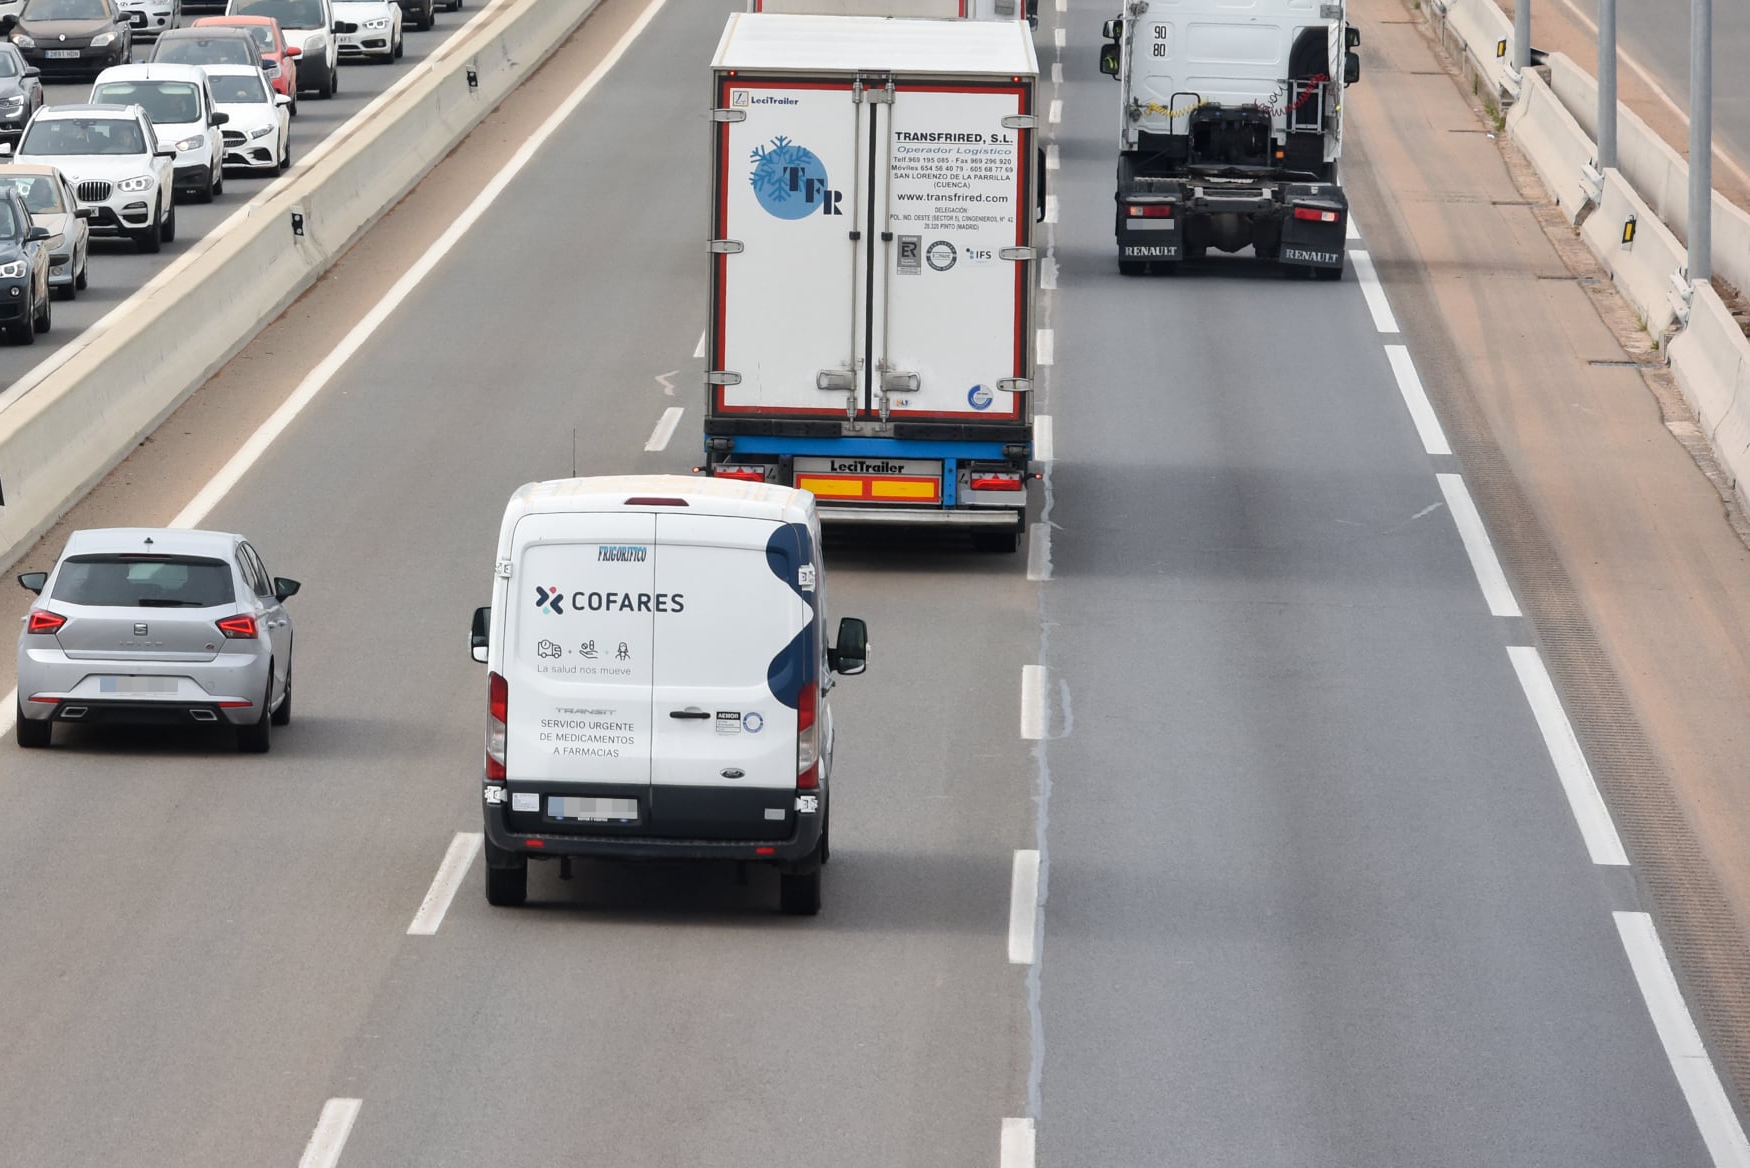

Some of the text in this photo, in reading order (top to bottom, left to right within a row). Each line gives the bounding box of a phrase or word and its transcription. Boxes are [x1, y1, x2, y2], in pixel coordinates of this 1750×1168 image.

[1153, 25, 1167, 40] 90
[1153, 43, 1166, 57] 80
[751, 96, 799, 106] LeciTrailer
[895, 132, 1013, 144] TRANSFRIRED, S.L.
[897, 145, 953, 155] Operador
[783, 167, 843, 215] TFR
[933, 181, 971, 189] (CUENCA)
[897, 193, 1008, 203] www.transfrired.com
[976, 251, 992, 260] IFS
[1124, 246, 1177, 256] RENAULT
[1285, 249, 1339, 263] RENAULT
[830, 460, 905, 474] LeciTrailer
[571, 591, 685, 613] COFARES
[537, 664, 632, 676] La salud nos mueve
[541, 718, 635, 732] SERVICIO URGENTE
[539, 732, 635, 744] DE MEDICAMENTOS
[553, 746, 619, 758] A FARMACIAS
